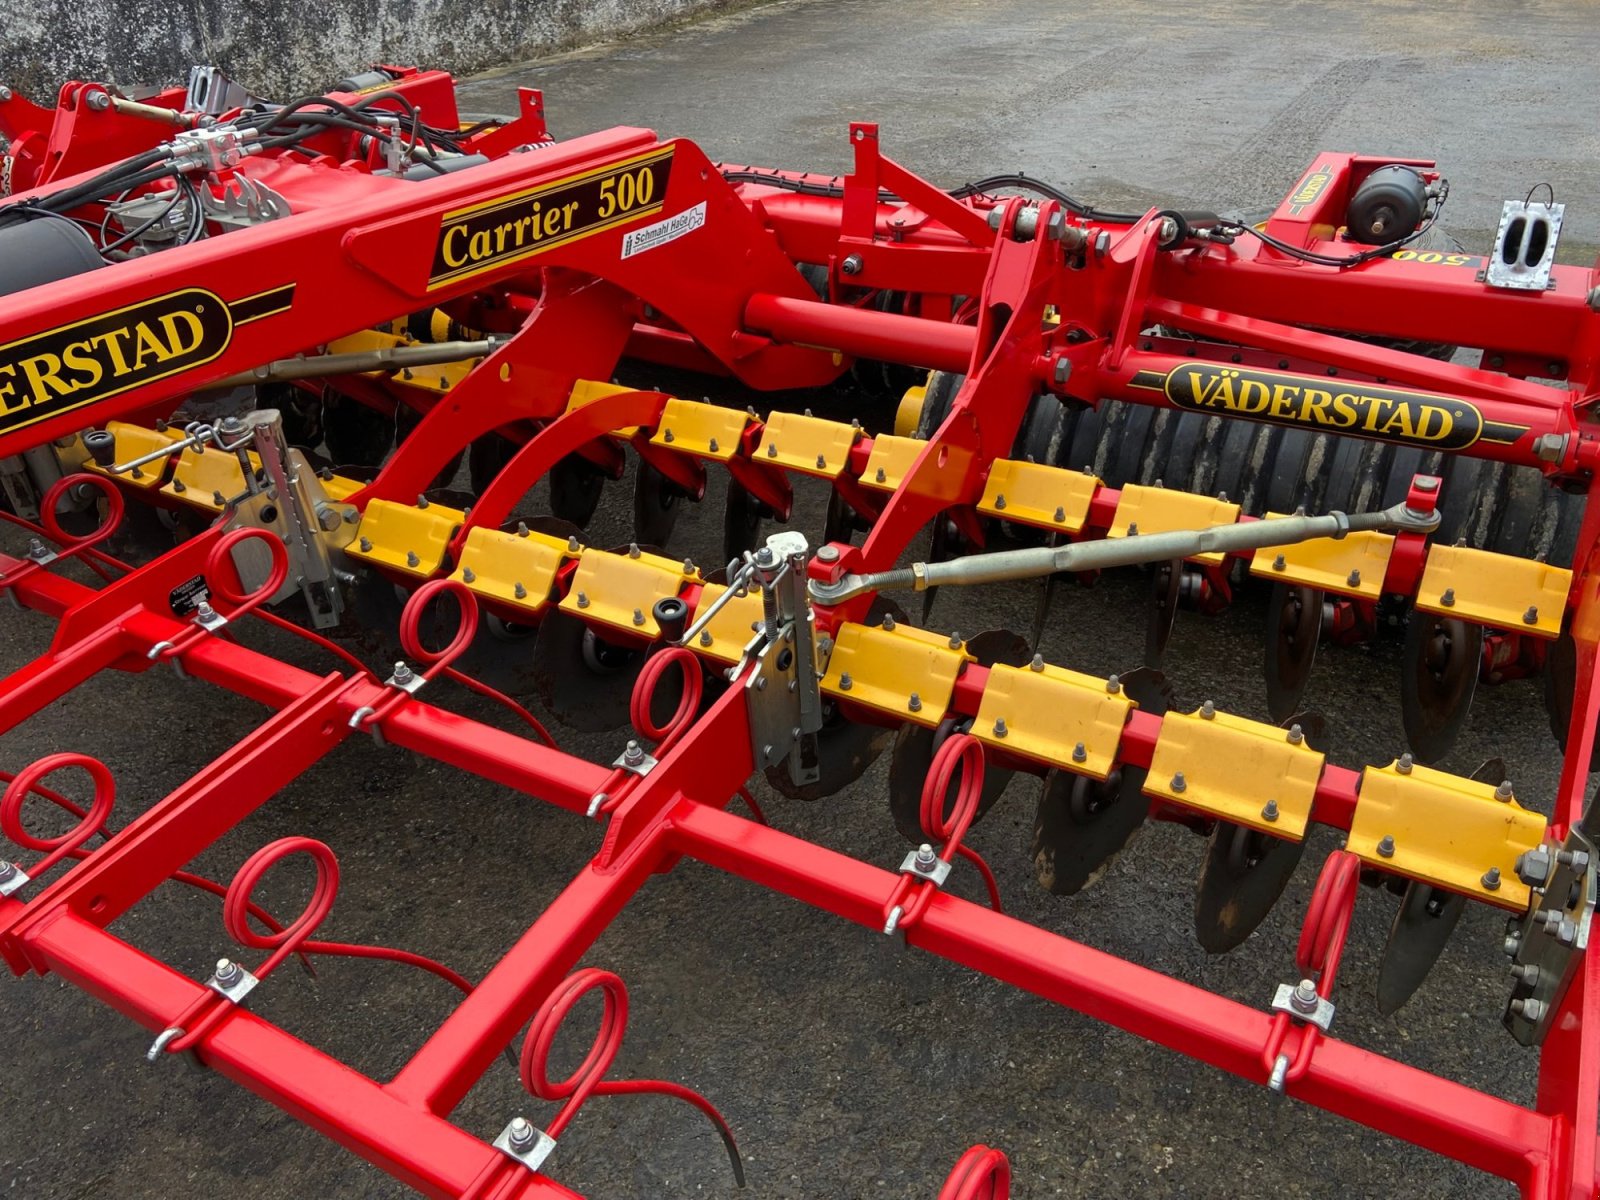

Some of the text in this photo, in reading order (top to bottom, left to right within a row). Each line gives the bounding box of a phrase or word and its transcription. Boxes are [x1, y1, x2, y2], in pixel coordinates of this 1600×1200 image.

[442, 166, 654, 268] Carrier 500
[634, 221, 669, 244] Schmahl
[1391, 250, 1471, 266] 500
[1187, 368, 1454, 441] VÄDERSTAD
